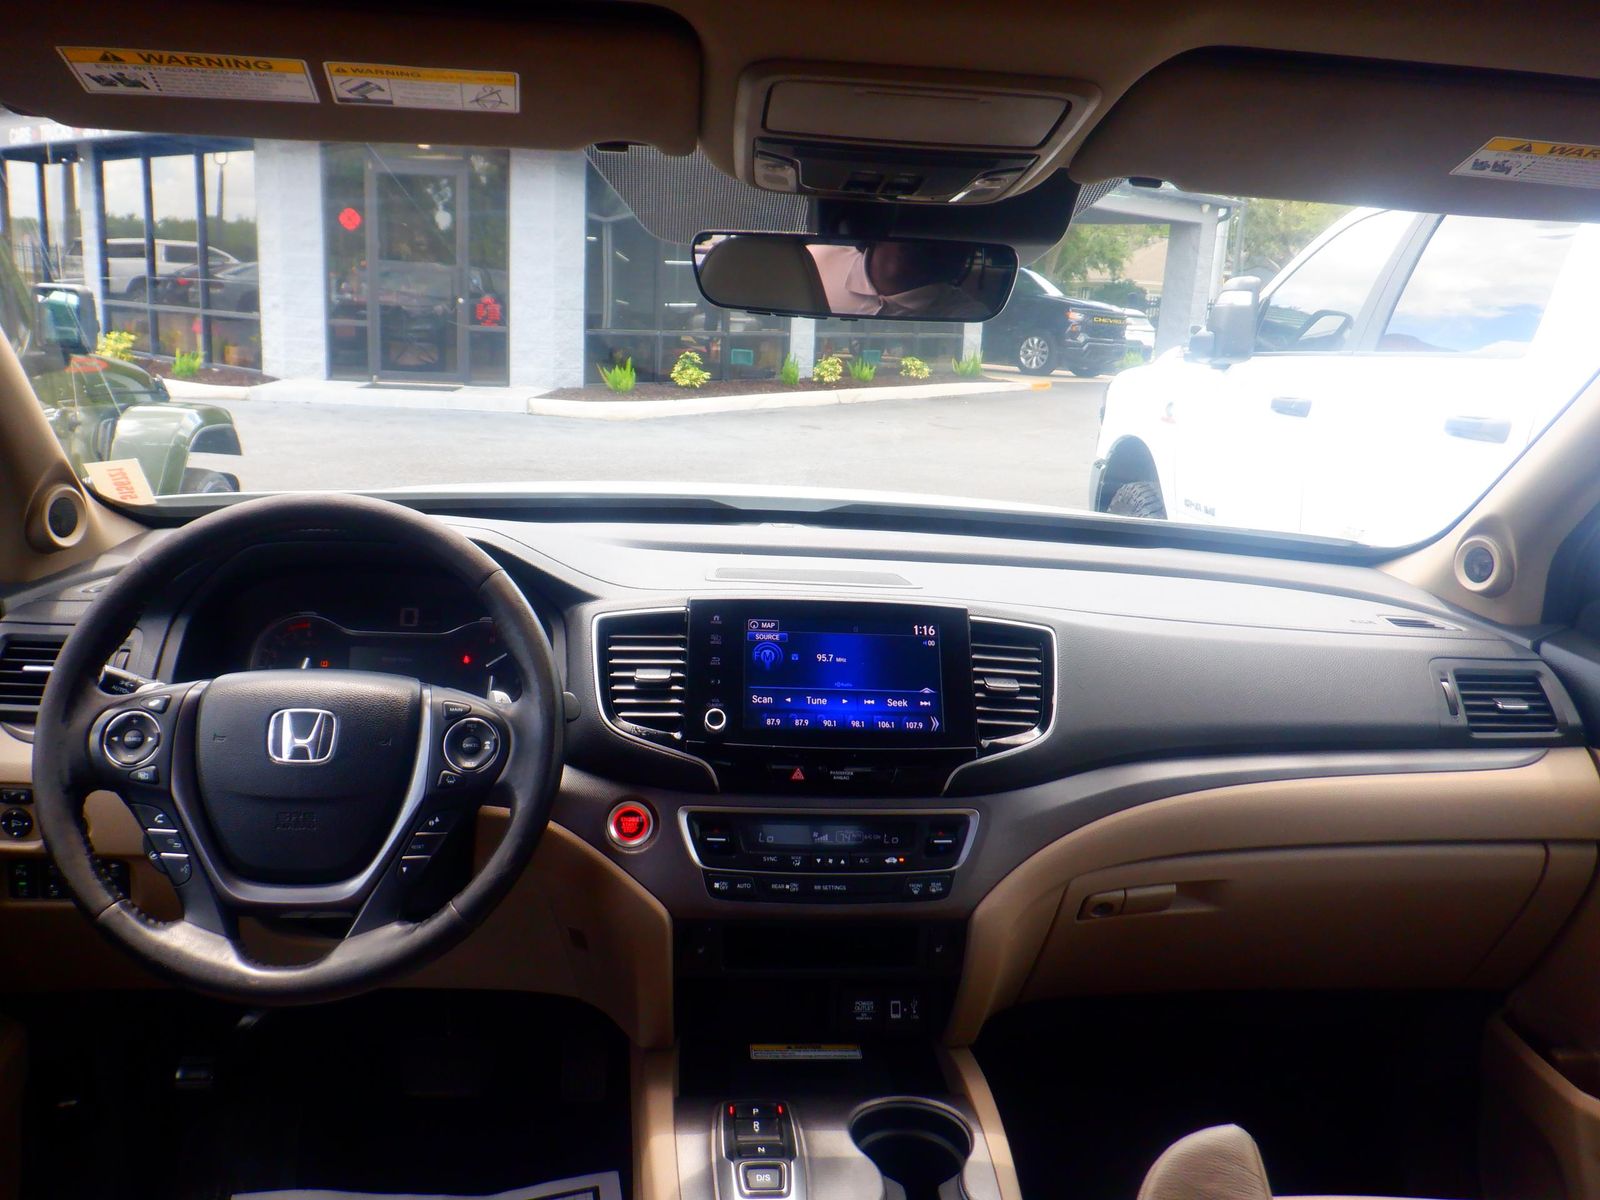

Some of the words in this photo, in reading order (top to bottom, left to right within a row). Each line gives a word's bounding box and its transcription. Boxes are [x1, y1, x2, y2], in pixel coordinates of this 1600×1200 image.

[137, 52, 273, 70] WARNING
[351, 67, 421, 78] WARNING
[913, 624, 935, 636] 1:16
[816, 653, 833, 662] 95.7
[752, 695, 773, 704] Scan
[806, 696, 827, 705] Tune
[887, 698, 908, 707] Seek
[766, 718, 781, 726] 87.9
[851, 720, 864, 728] 98.1
[877, 720, 894, 728] 106.1
[906, 721, 923, 729] 107.9
[756, 1174, 771, 1183] D/S
